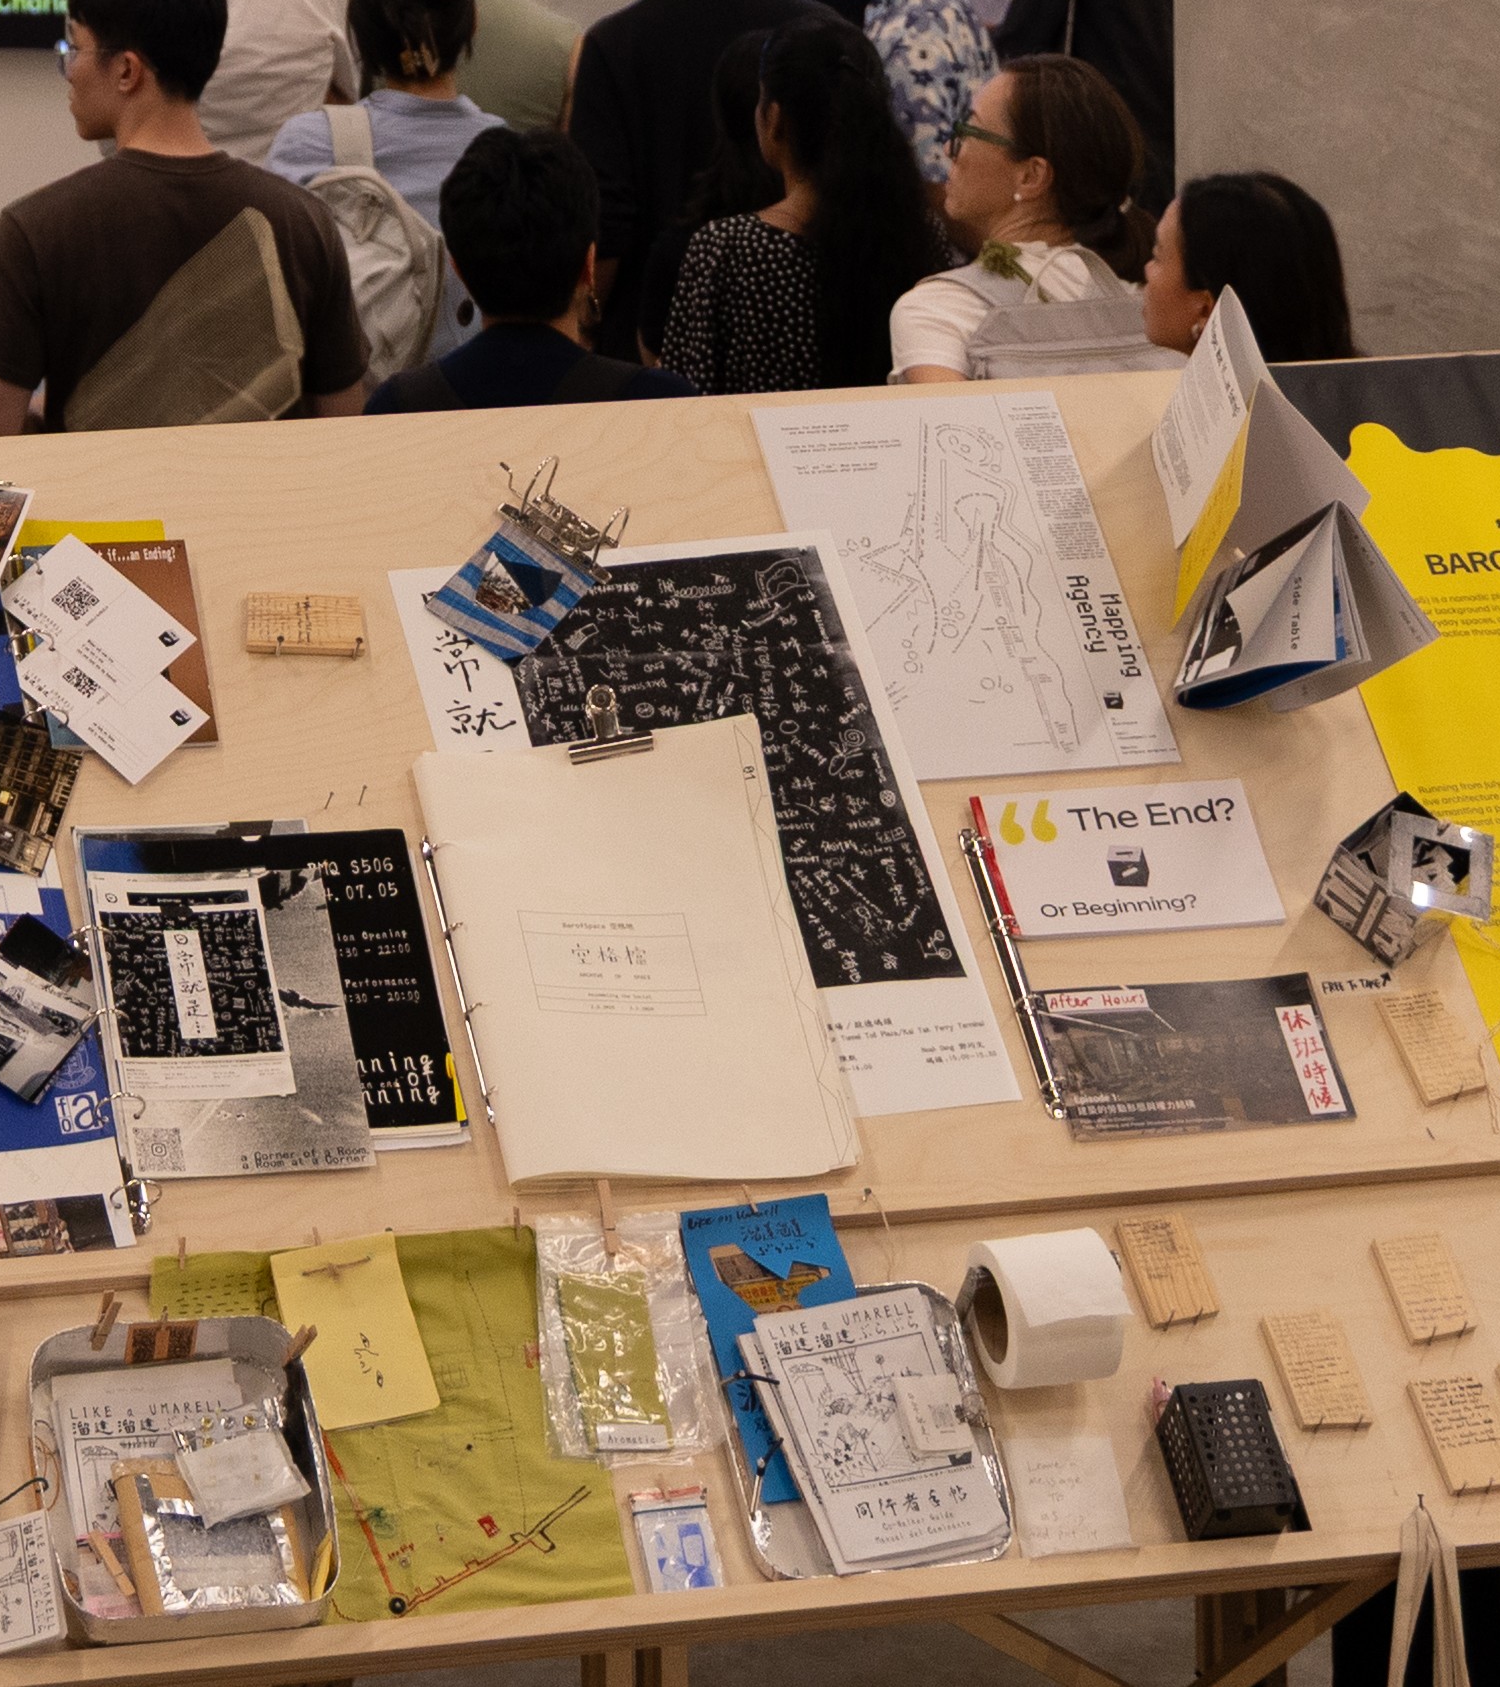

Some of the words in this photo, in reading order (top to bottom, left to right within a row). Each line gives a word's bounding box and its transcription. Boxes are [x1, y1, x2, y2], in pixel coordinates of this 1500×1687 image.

[1066, 574, 1107, 654] Agency
[1100, 593, 1142, 678] Mapping
[1067, 806, 1140, 832] The
[1147, 797, 1235, 828] End?
[350, 858, 394, 874] S506
[1039, 902, 1068, 919] Or
[1071, 893, 1198, 919] Beginning?
[1049, 994, 1093, 1010] After
[1101, 992, 1146, 1008] Hours
[254, 1151, 295, 1161] Corner
[607, 1434, 656, 1444] Aromatic
